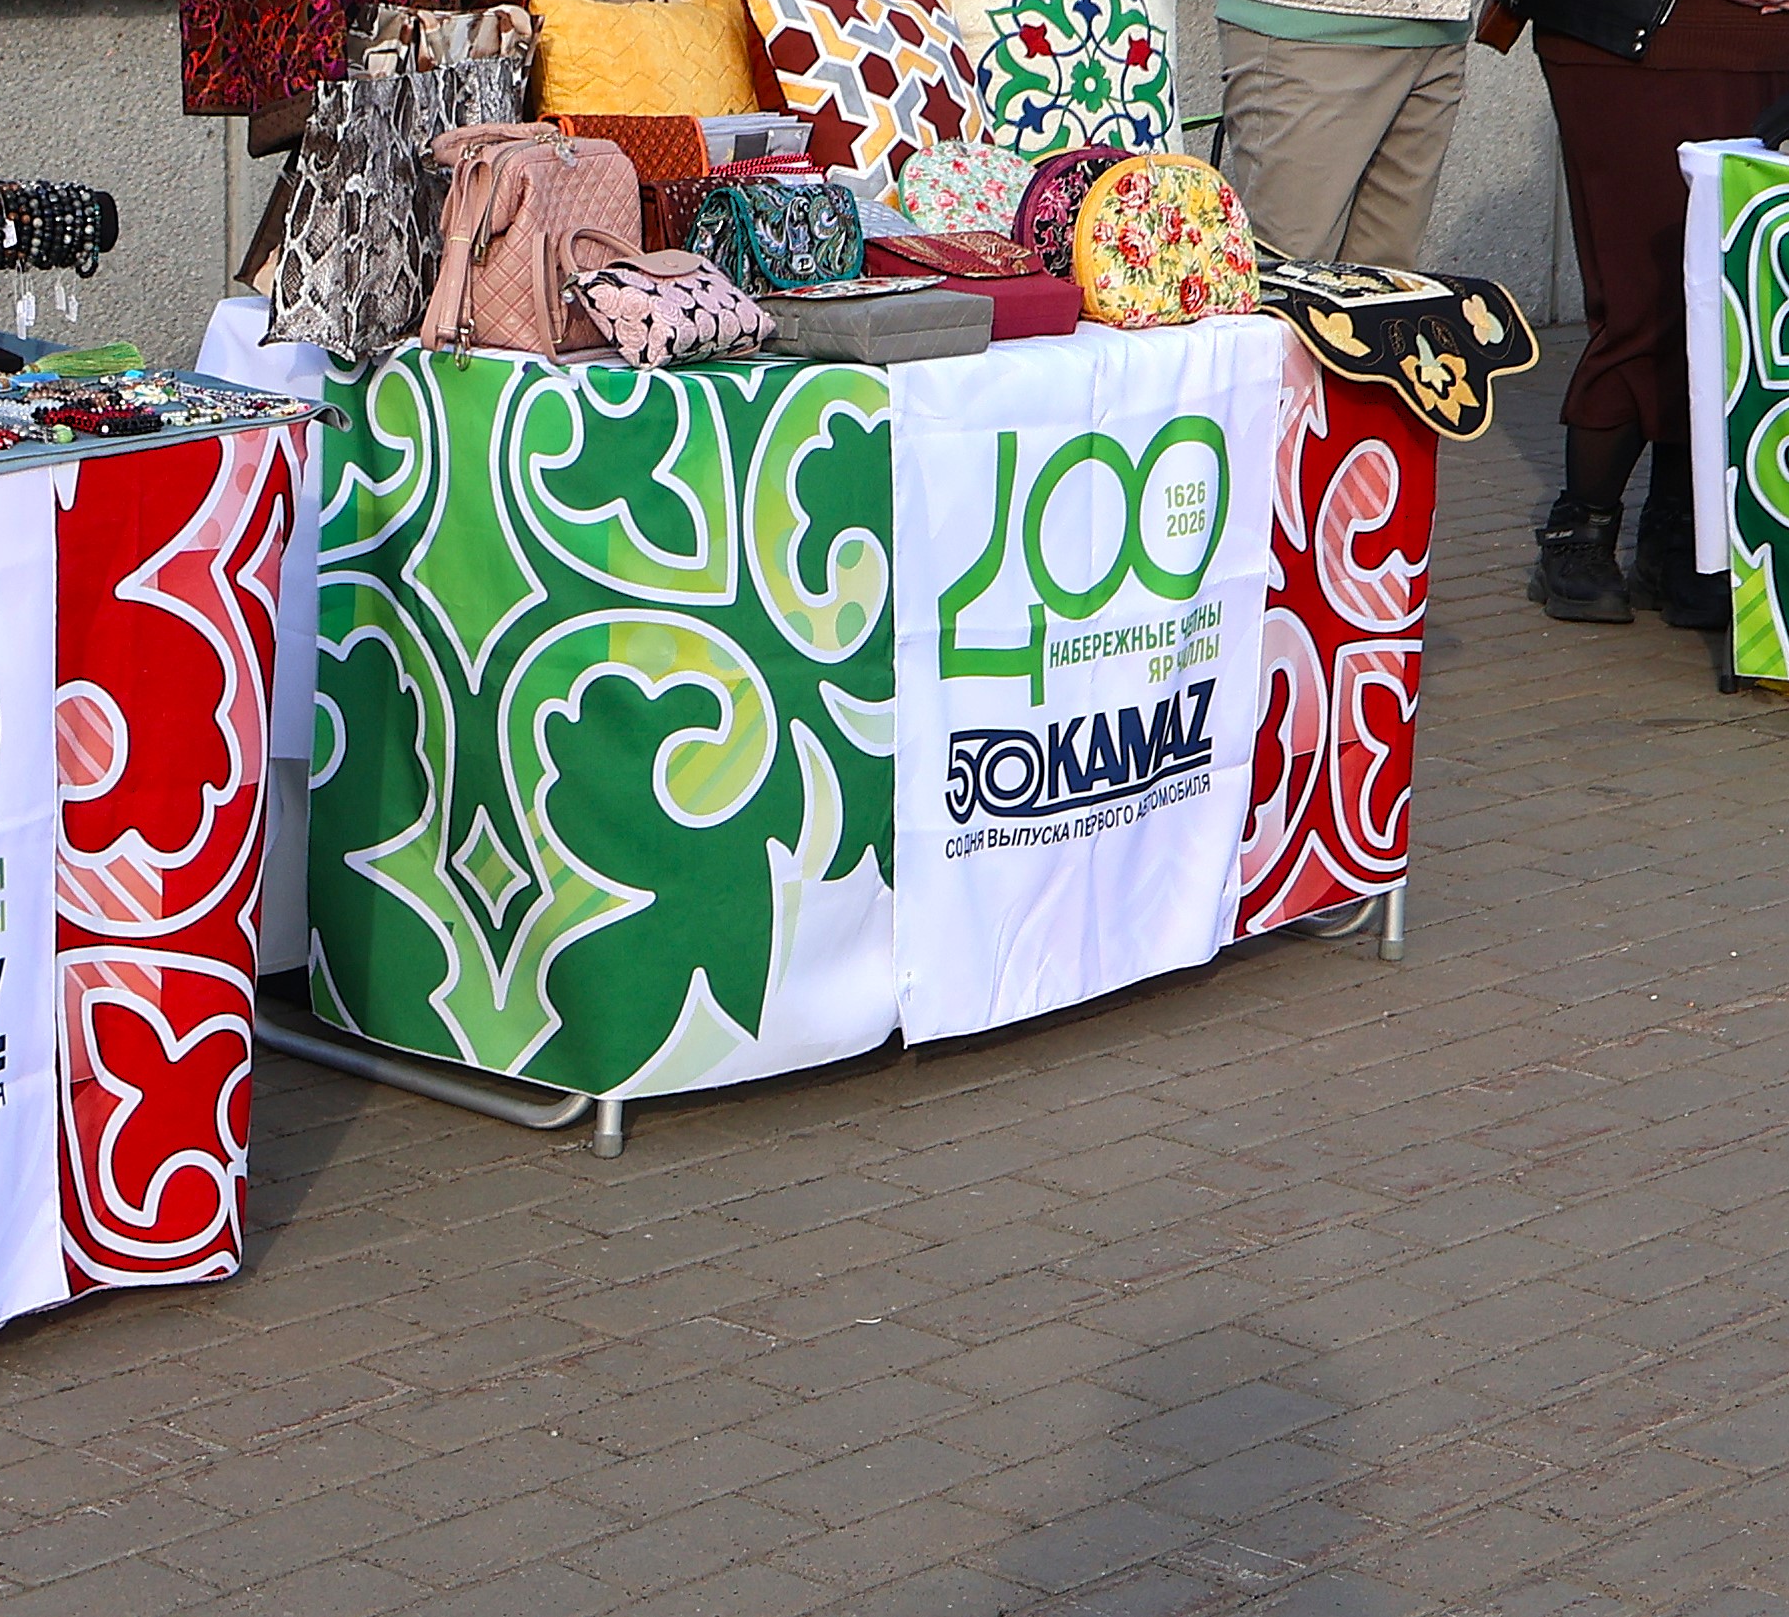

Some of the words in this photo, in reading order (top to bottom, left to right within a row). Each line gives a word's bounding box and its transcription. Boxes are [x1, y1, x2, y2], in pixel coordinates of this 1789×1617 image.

[1164, 480, 1206, 509] 1626
[1166, 508, 1206, 537] 2026
[937, 414, 1229, 708] 400
[1049, 620, 1177, 669] НАБЕРЕЖНЫЕ
[1148, 654, 1174, 683] ЯР
[1048, 677, 1217, 801] KAMAZ
[988, 821, 1070, 849] ВЫПУСКА
[1074, 804, 1134, 839] ПЕРВОГО
